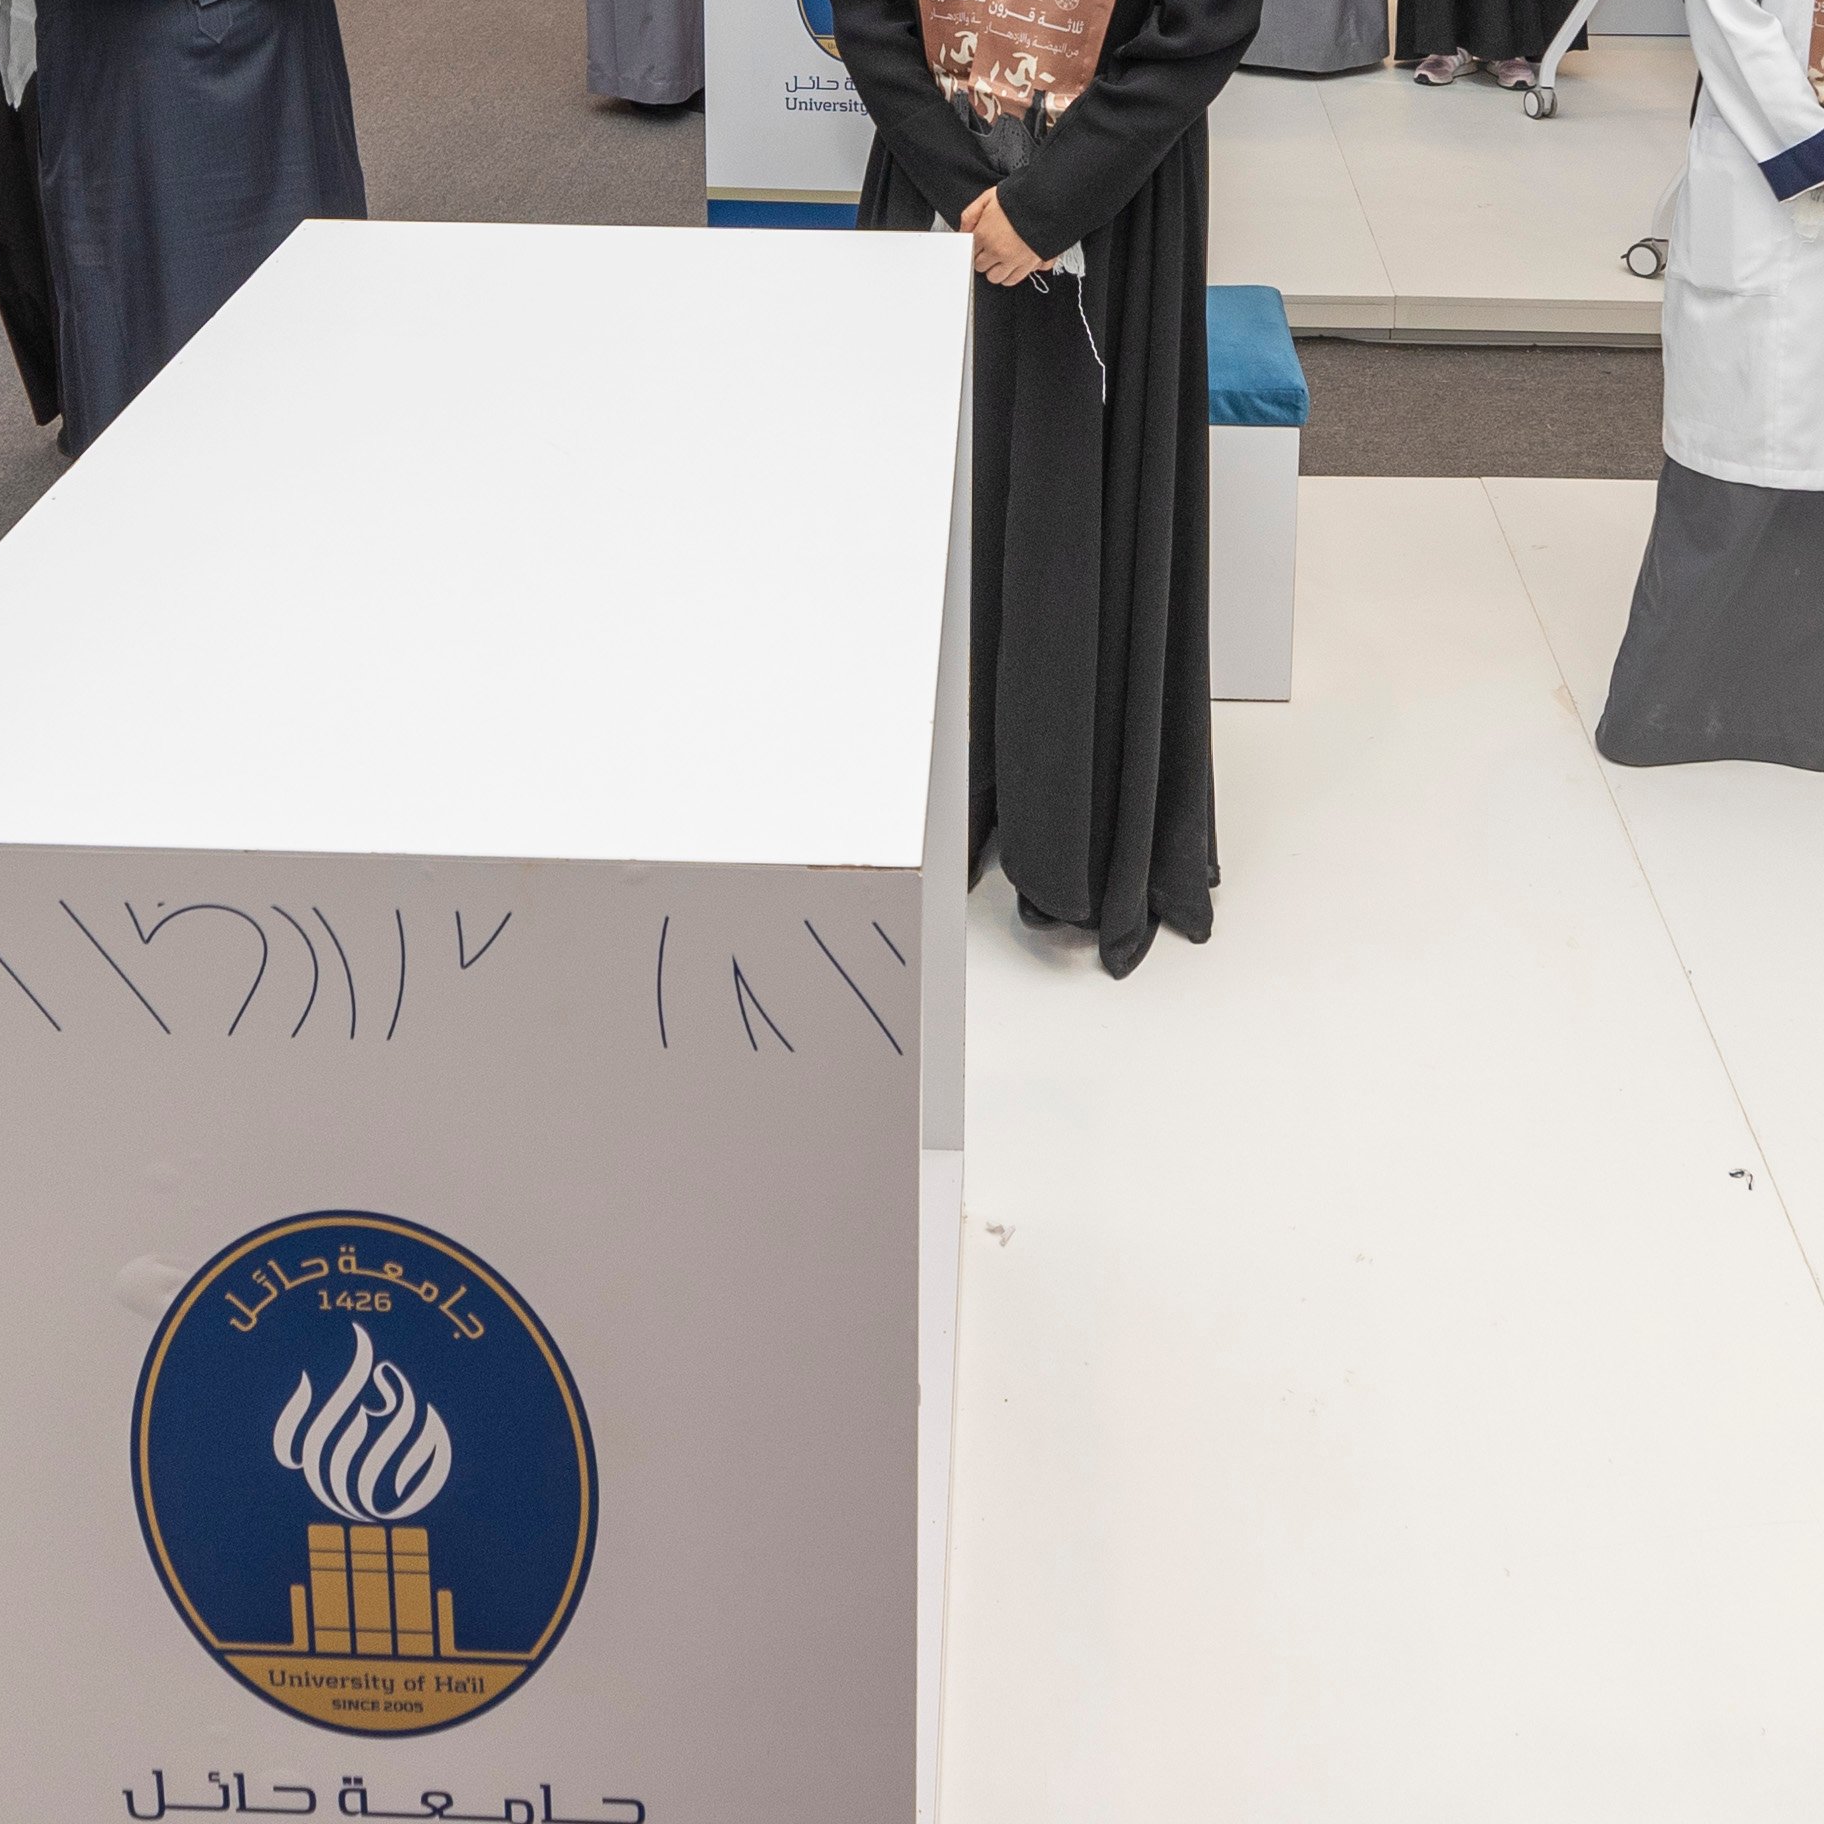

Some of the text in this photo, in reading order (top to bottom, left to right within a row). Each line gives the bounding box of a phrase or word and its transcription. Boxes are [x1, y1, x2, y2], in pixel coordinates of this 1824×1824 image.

[784, 75, 840, 93] حائل
[785, 96, 869, 116] University
[224, 1244, 486, 1341] جامعة حائل
[317, 1289, 393, 1312] 1426
[268, 1669, 486, 1695] University of Ha'il
[332, 1699, 424, 1714] SINCE 2005
[122, 1769, 318, 1822] حائل
